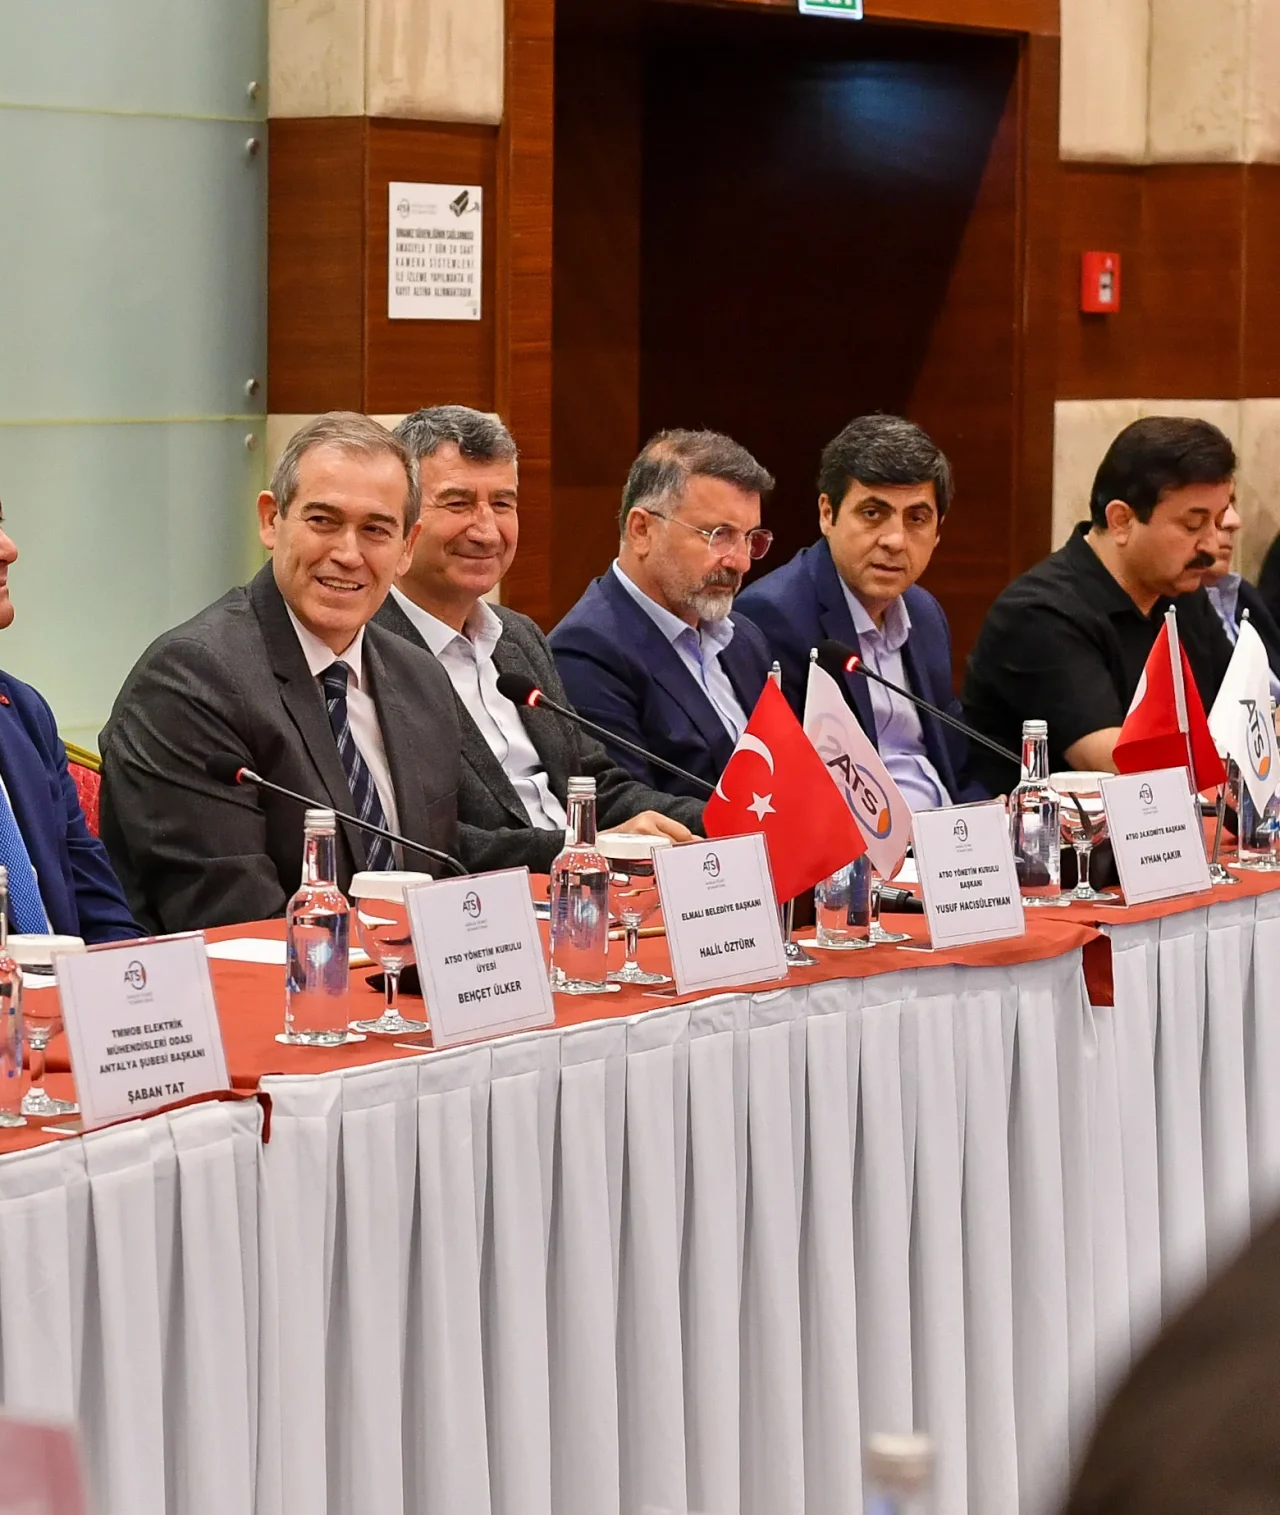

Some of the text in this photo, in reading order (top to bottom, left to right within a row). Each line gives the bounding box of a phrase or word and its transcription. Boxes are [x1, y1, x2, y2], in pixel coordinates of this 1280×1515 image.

[1140, 849, 1182, 865] AYHAN ÇAKIR
[938, 870, 953, 879] ATSO
[978, 864, 1000, 875] KURULU
[681, 898, 762, 921] ELMALI BELEDİYE BAŞKANI
[935, 896, 1011, 914] YUSUF HACISÜLEYMAN
[444, 941, 523, 965] ATSO YÖNETİM KURULU
[699, 937, 756, 958] HALİL ÖZTÜRK
[476, 961, 497, 973] ÜYESİ
[457, 980, 522, 1004] BEHÇET ÜLKER
[111, 1018, 183, 1039] TMMOB ELEKTRİK
[106, 1034, 194, 1056] MÜHENDİSLERİ ODASI
[99, 1048, 206, 1074] ANTALYA ŞUBESİ BAŞKANI
[127, 1081, 186, 1105] ŞABAN TAT
